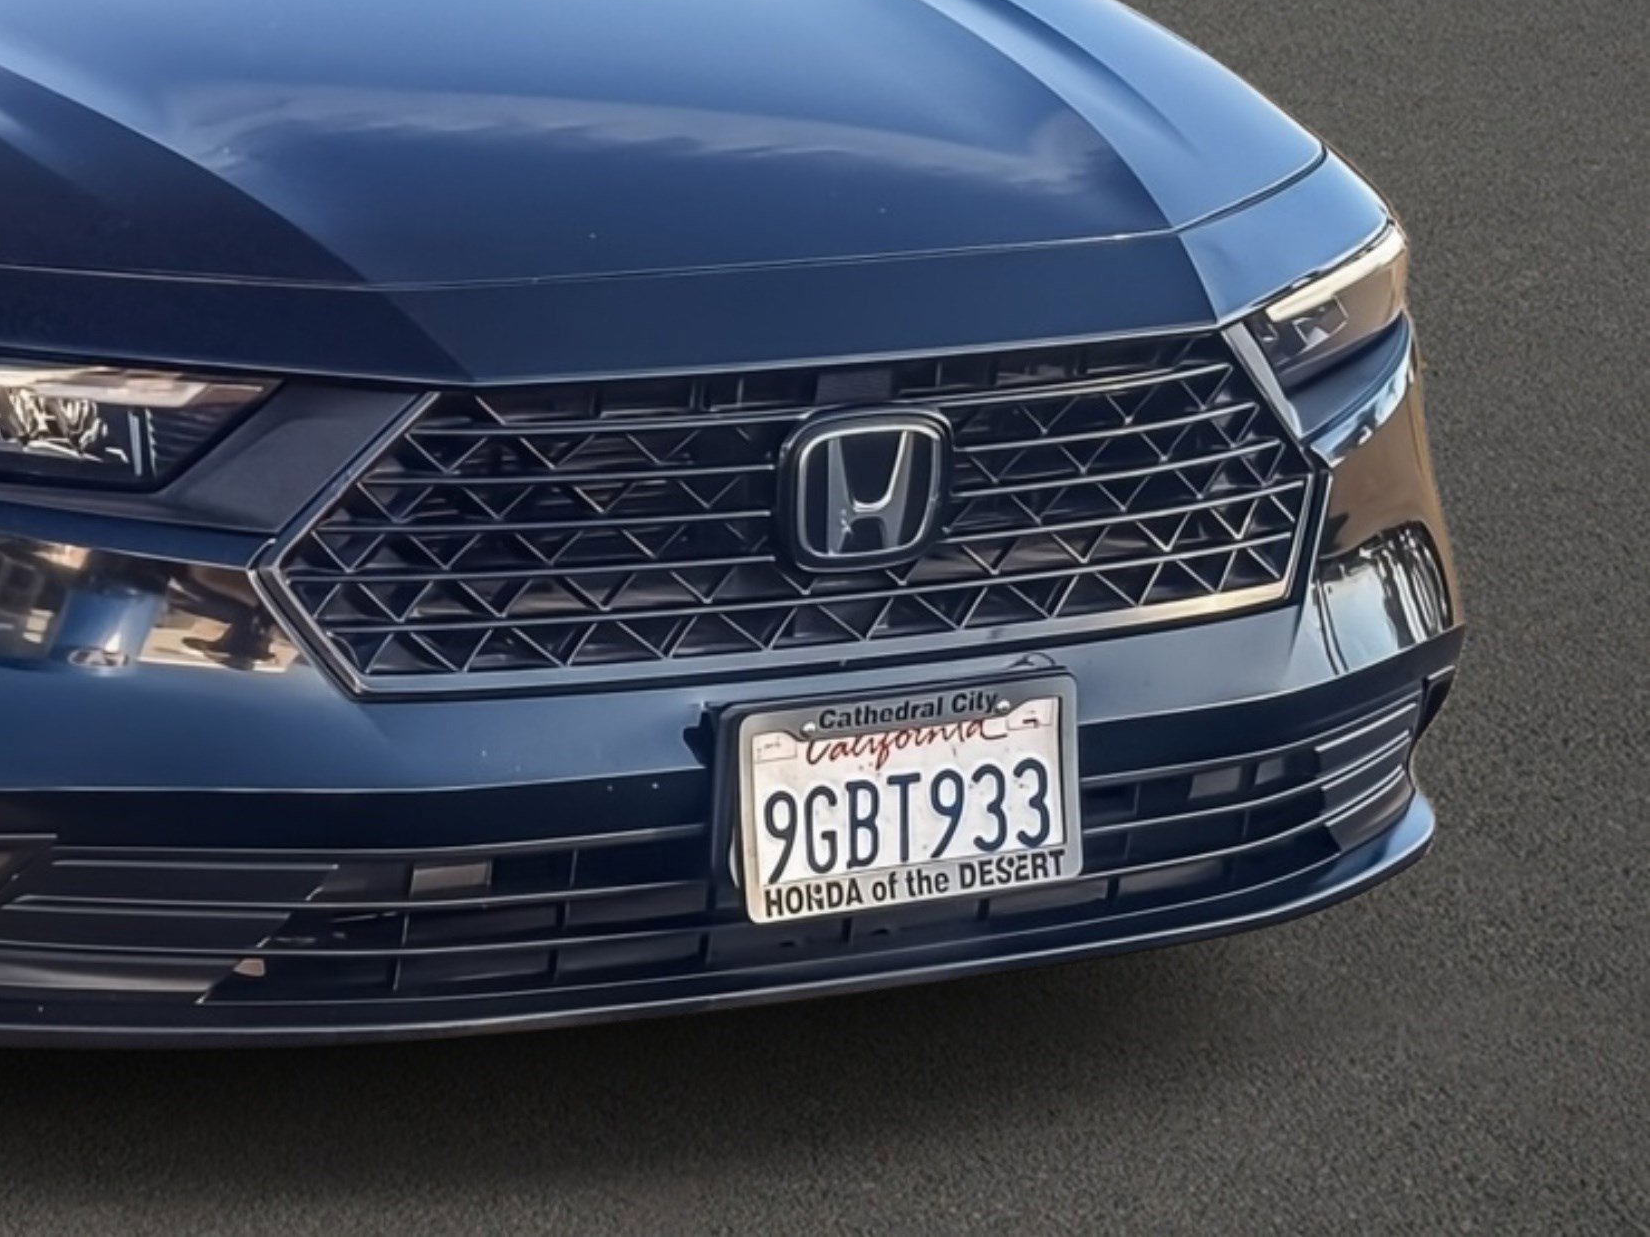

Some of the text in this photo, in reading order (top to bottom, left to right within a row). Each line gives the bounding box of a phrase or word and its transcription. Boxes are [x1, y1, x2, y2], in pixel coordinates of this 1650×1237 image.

[818, 690, 1000, 730] Cathedral City
[763, 756, 1052, 885] 9GBT933
[764, 848, 1067, 918] HONDA of the DESERT
